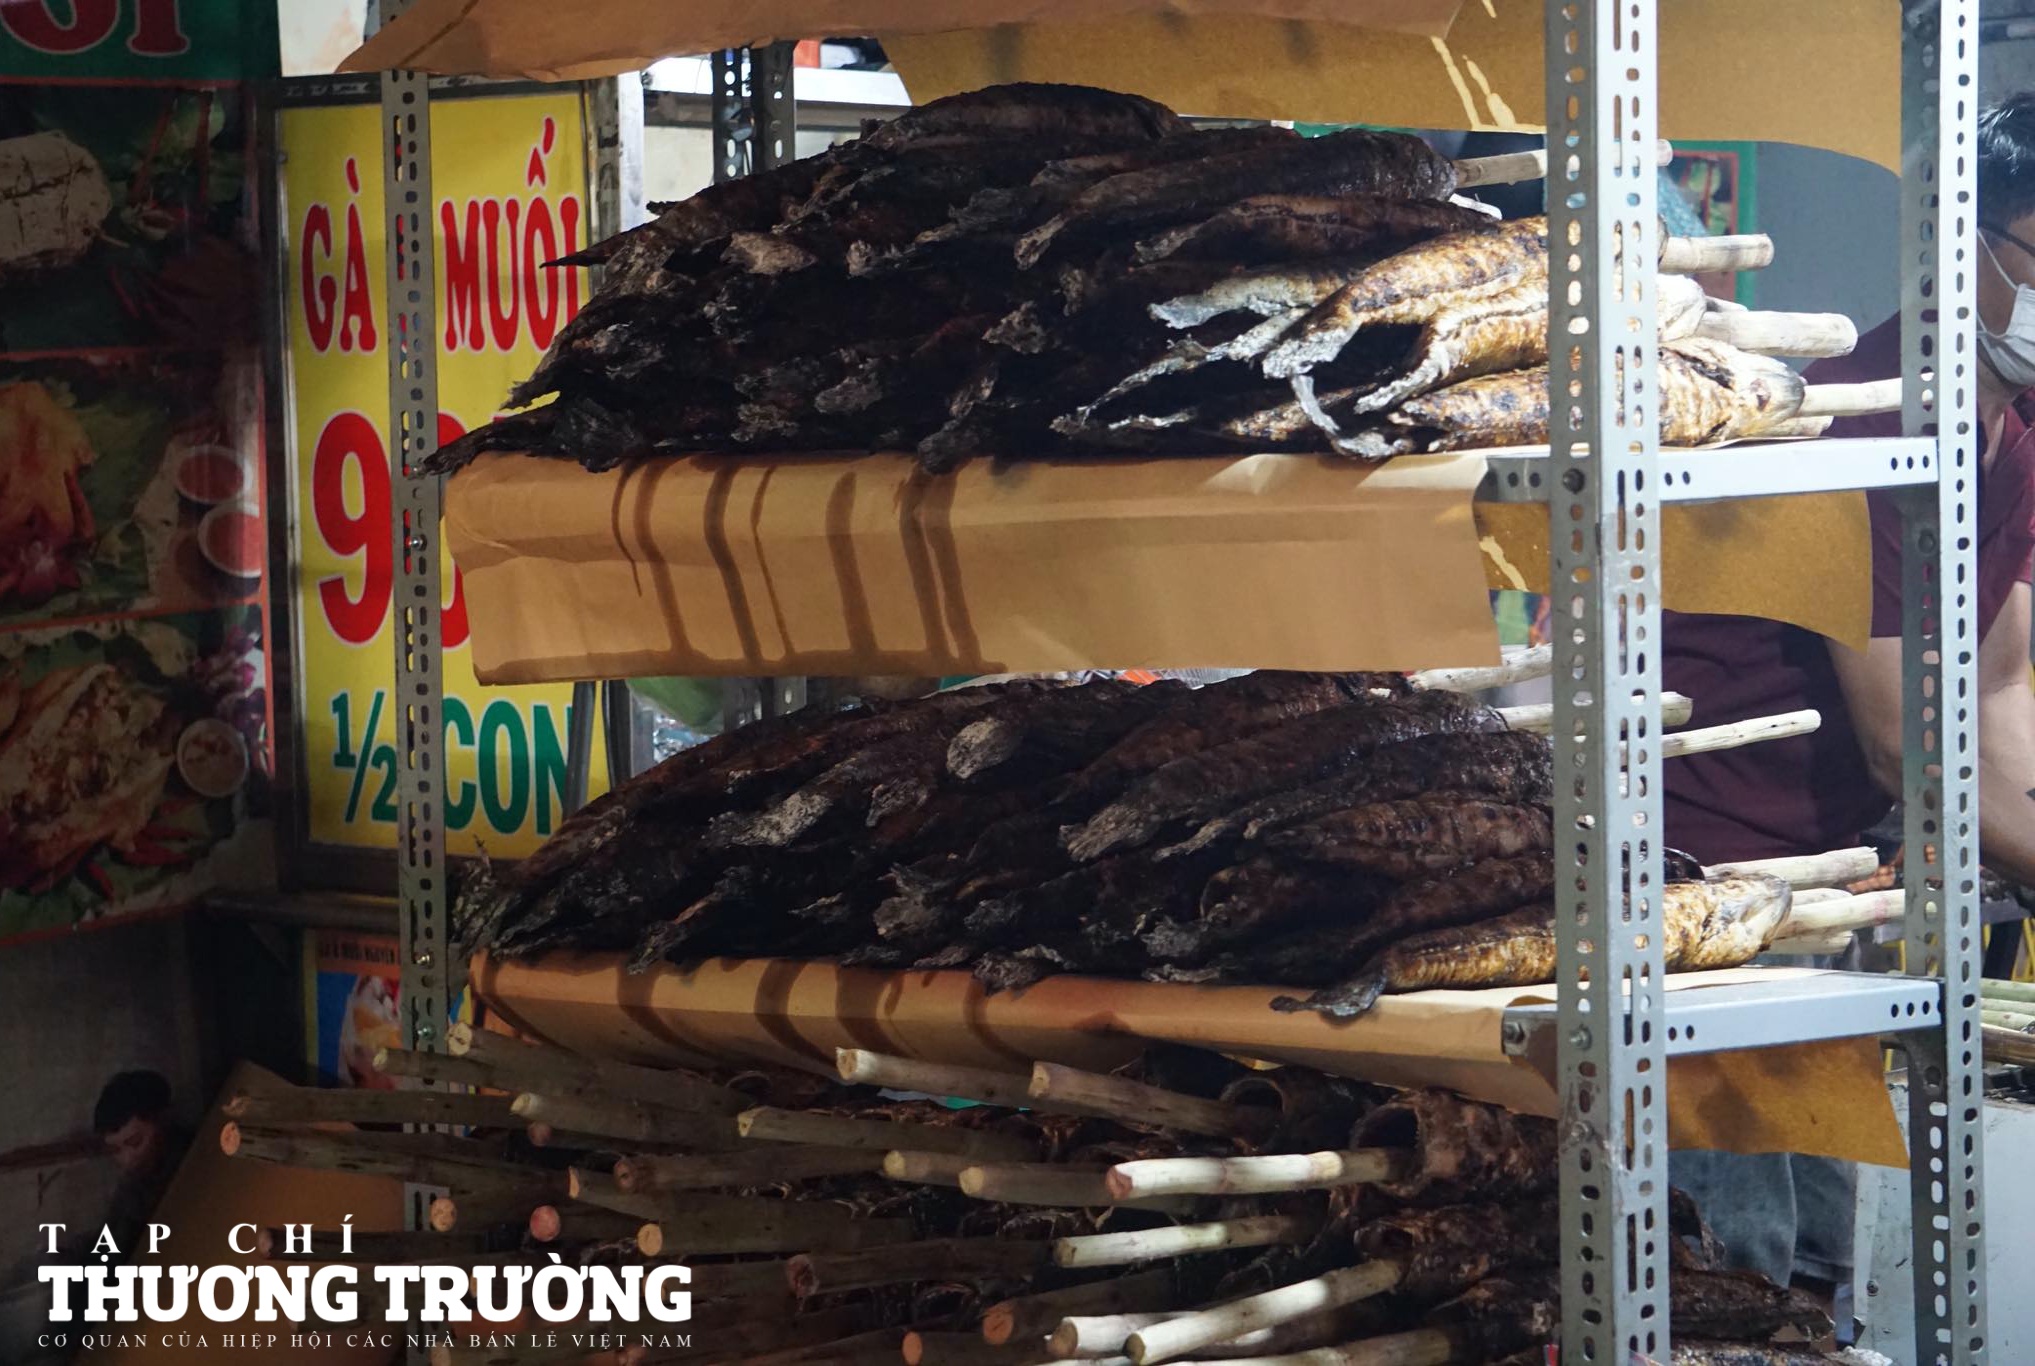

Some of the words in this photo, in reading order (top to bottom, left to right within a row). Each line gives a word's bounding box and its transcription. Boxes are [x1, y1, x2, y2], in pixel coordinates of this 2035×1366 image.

[303, 158, 377, 351] GÀ
[441, 117, 578, 351] MUỐI
[442, 697, 574, 836] CON
